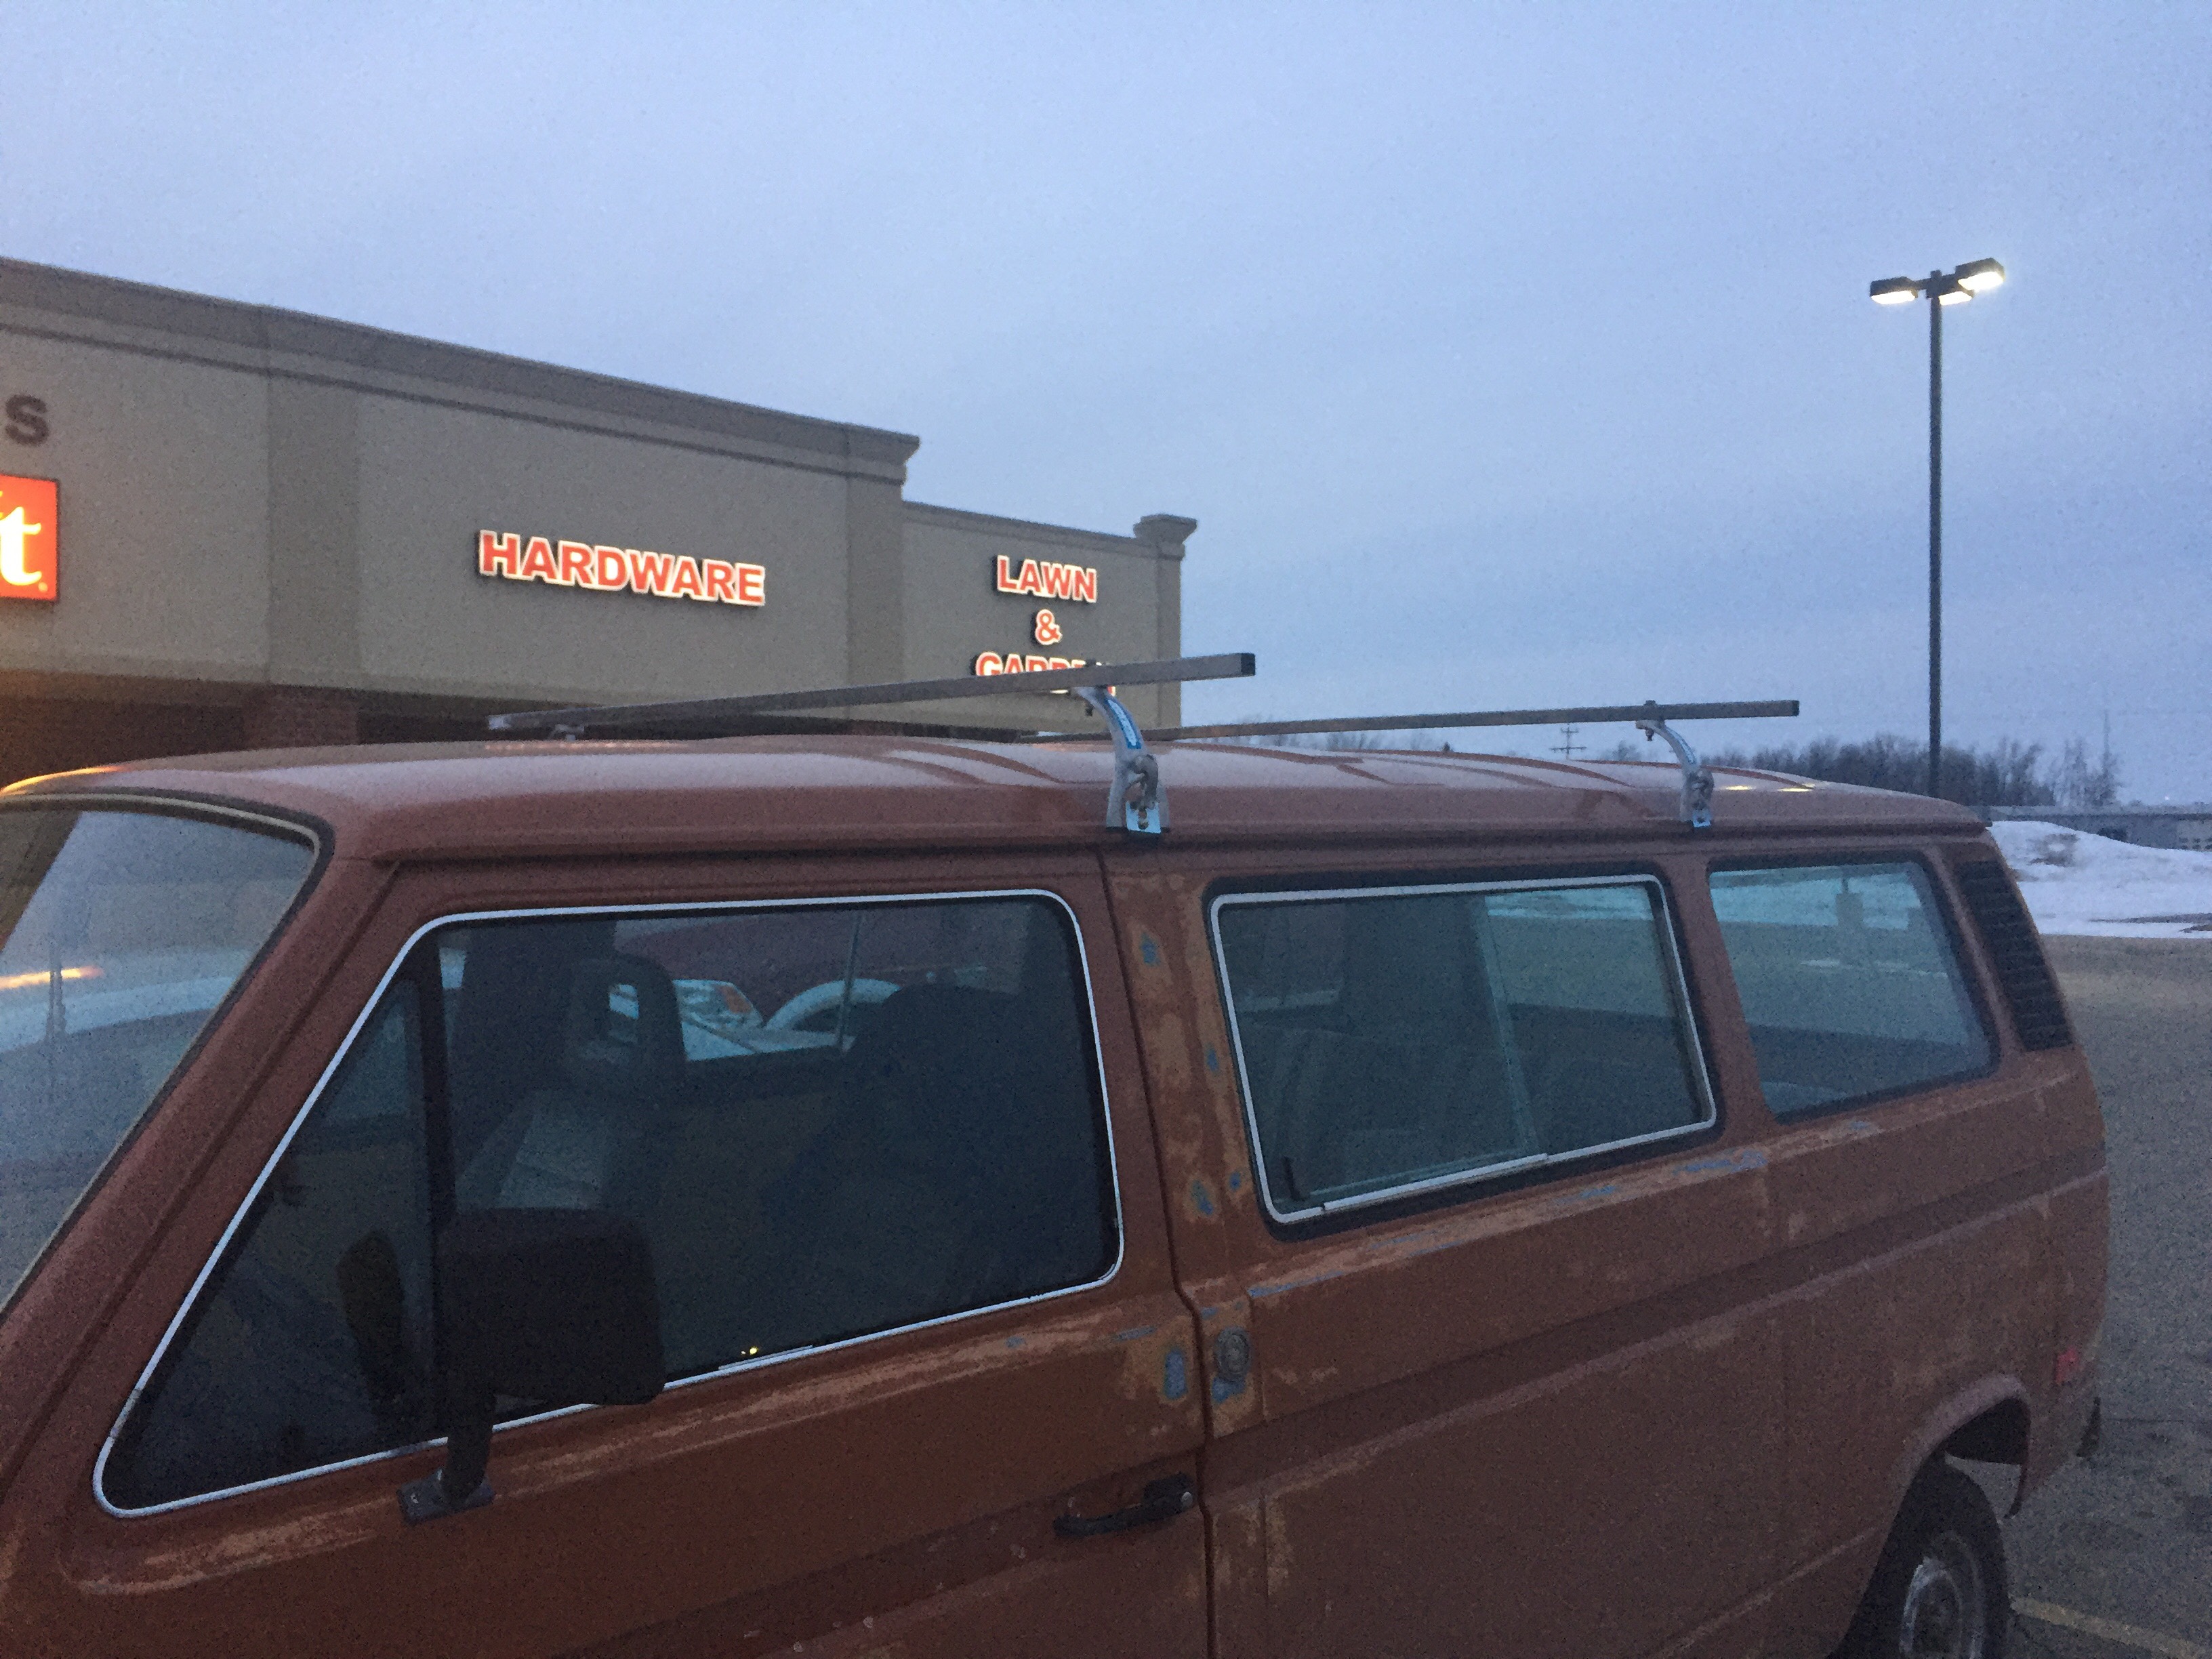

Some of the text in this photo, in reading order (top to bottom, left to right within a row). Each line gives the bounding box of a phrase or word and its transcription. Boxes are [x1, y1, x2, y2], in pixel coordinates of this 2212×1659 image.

[480, 530, 765, 607] HARDWARE
[997, 555, 1097, 603] LAWN
[1035, 609, 1063, 645] &
